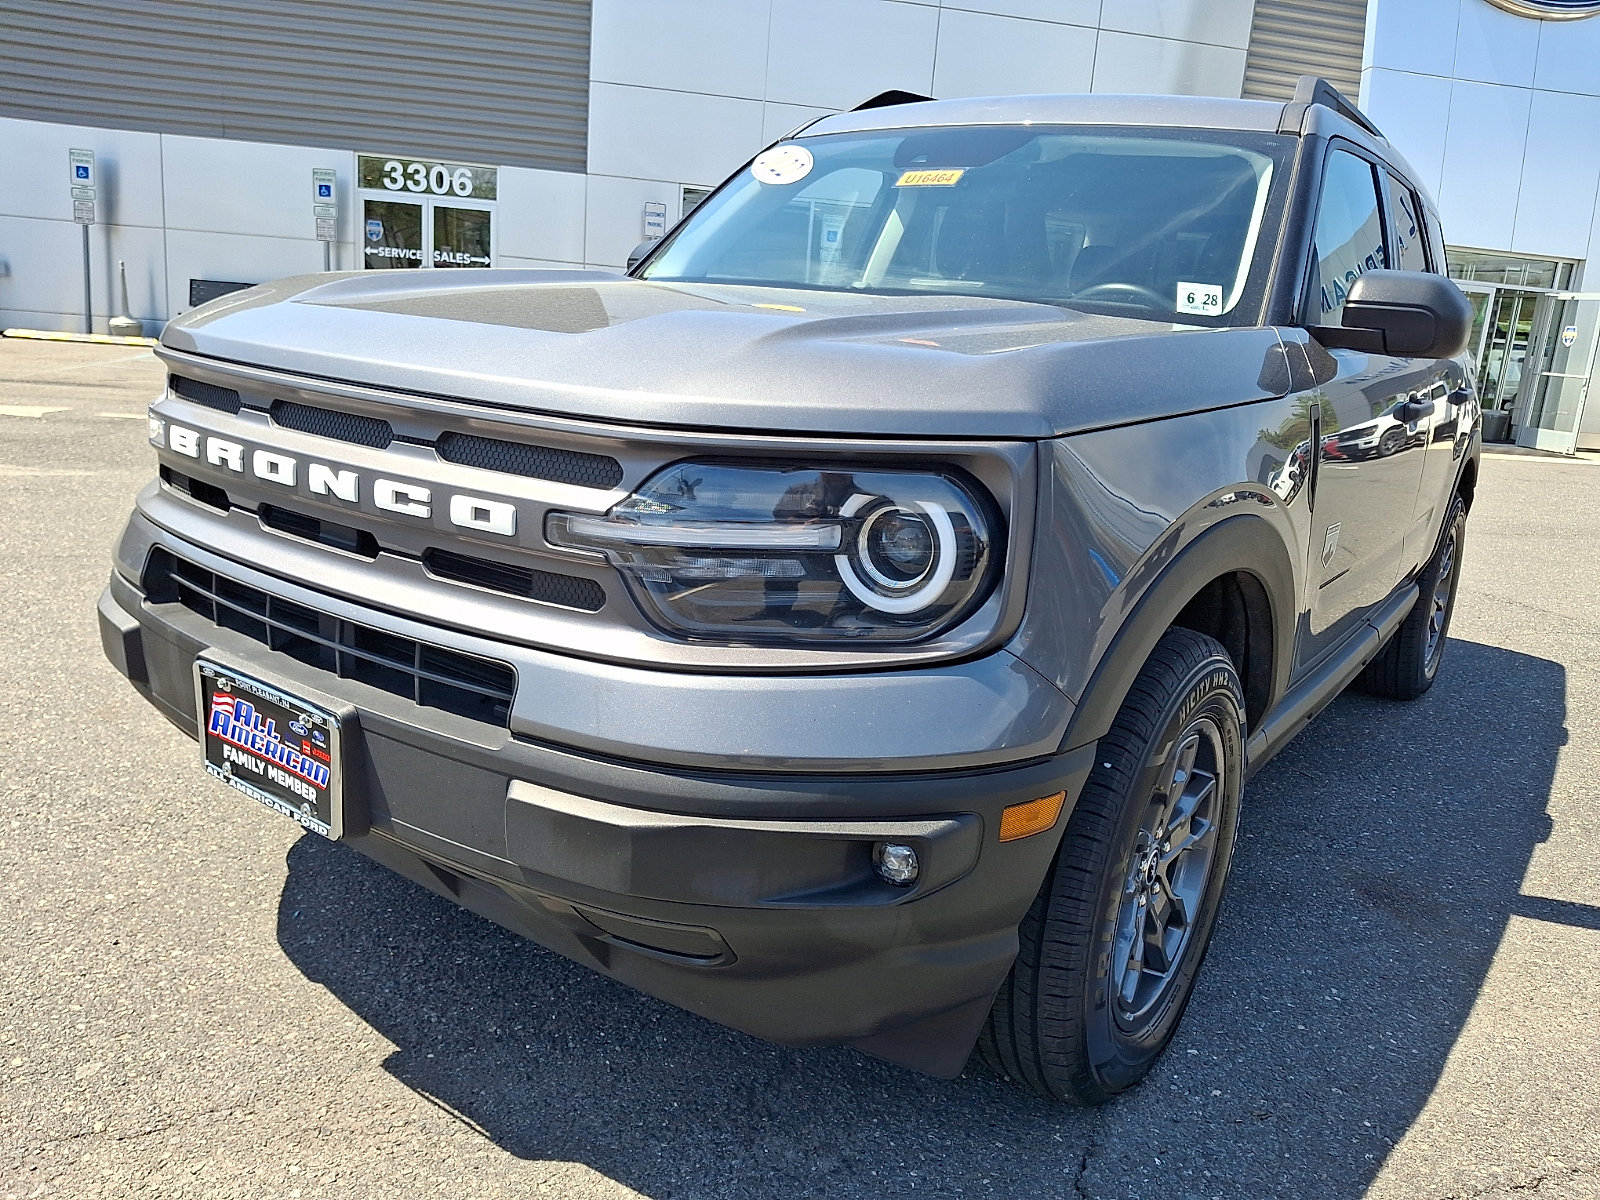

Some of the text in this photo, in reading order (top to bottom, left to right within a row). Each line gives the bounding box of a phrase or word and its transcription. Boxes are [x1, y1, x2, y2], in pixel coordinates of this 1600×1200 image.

[383, 161, 473, 197] 3306
[904, 172, 954, 185] U16464
[378, 246, 423, 260] SERVICE
[433, 250, 471, 264] SALES
[1187, 292, 1218, 307] 6 28
[168, 423, 517, 537] BRONCO
[222, 743, 317, 805] FAMILY MEMBER
[206, 766, 329, 836] ALL AMERICAN FORD
